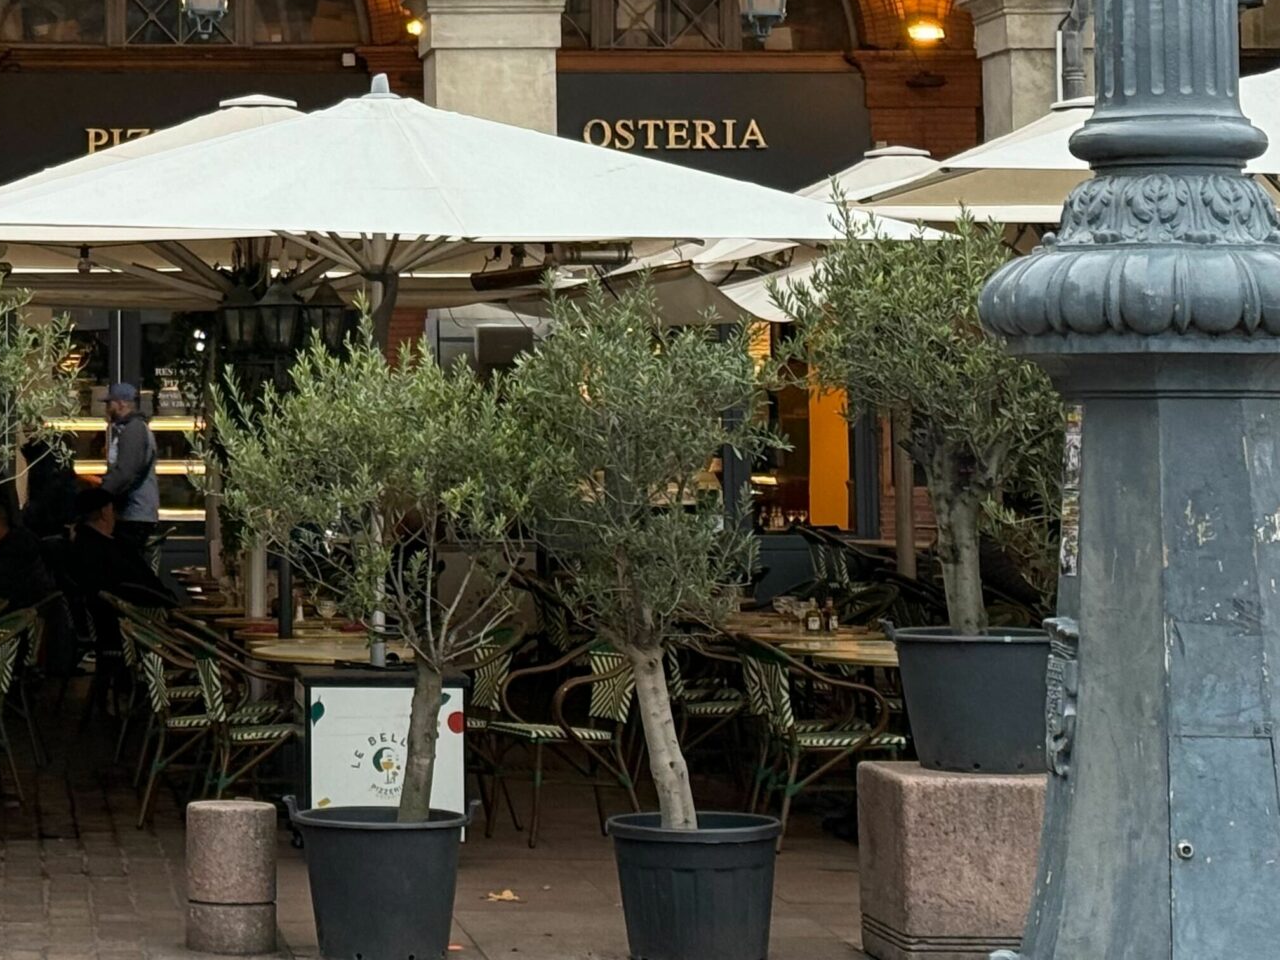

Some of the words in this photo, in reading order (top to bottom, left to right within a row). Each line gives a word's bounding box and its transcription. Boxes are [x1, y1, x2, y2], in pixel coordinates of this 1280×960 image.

[583, 118, 768, 149] OSTERIA
[351, 750, 364, 768] LE
[368, 733, 407, 747] BELL
